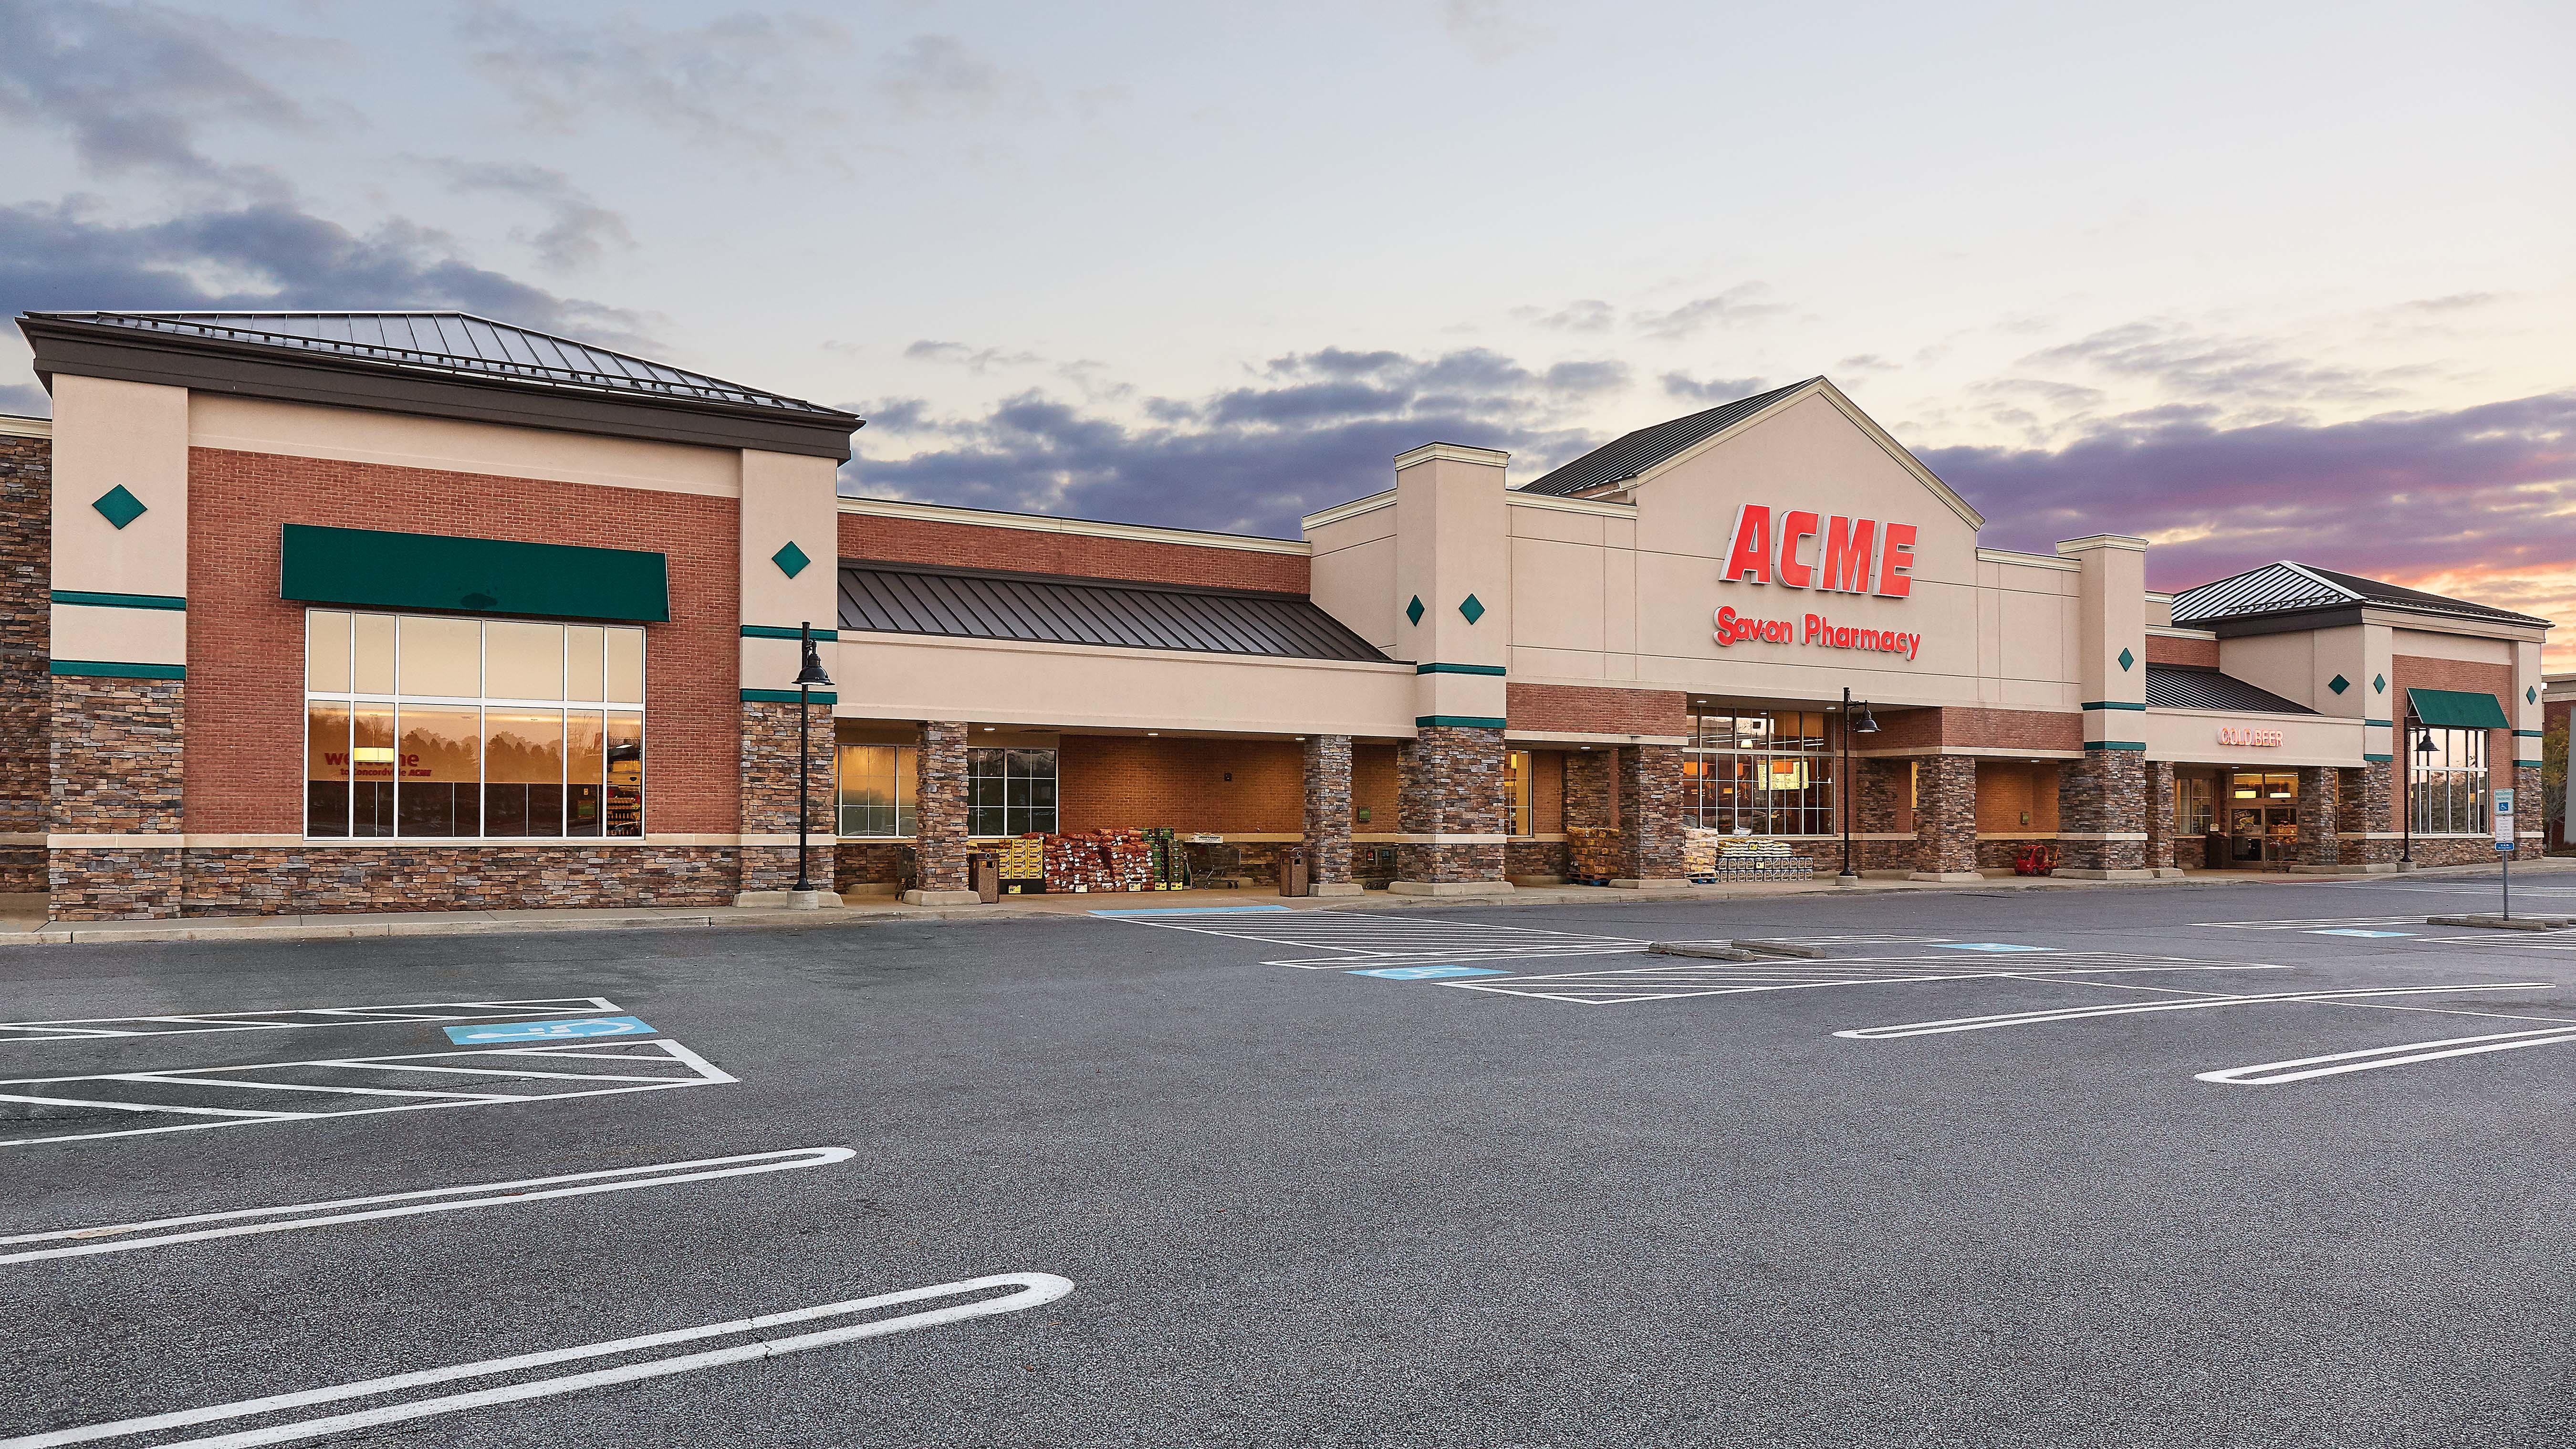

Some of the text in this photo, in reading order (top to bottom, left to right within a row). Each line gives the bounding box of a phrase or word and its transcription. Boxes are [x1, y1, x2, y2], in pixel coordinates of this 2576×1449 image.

[1719, 503, 1918, 598] ACME
[1800, 613, 1921, 661] Pharmacy
[2219, 727, 2284, 747] COLD BEER
